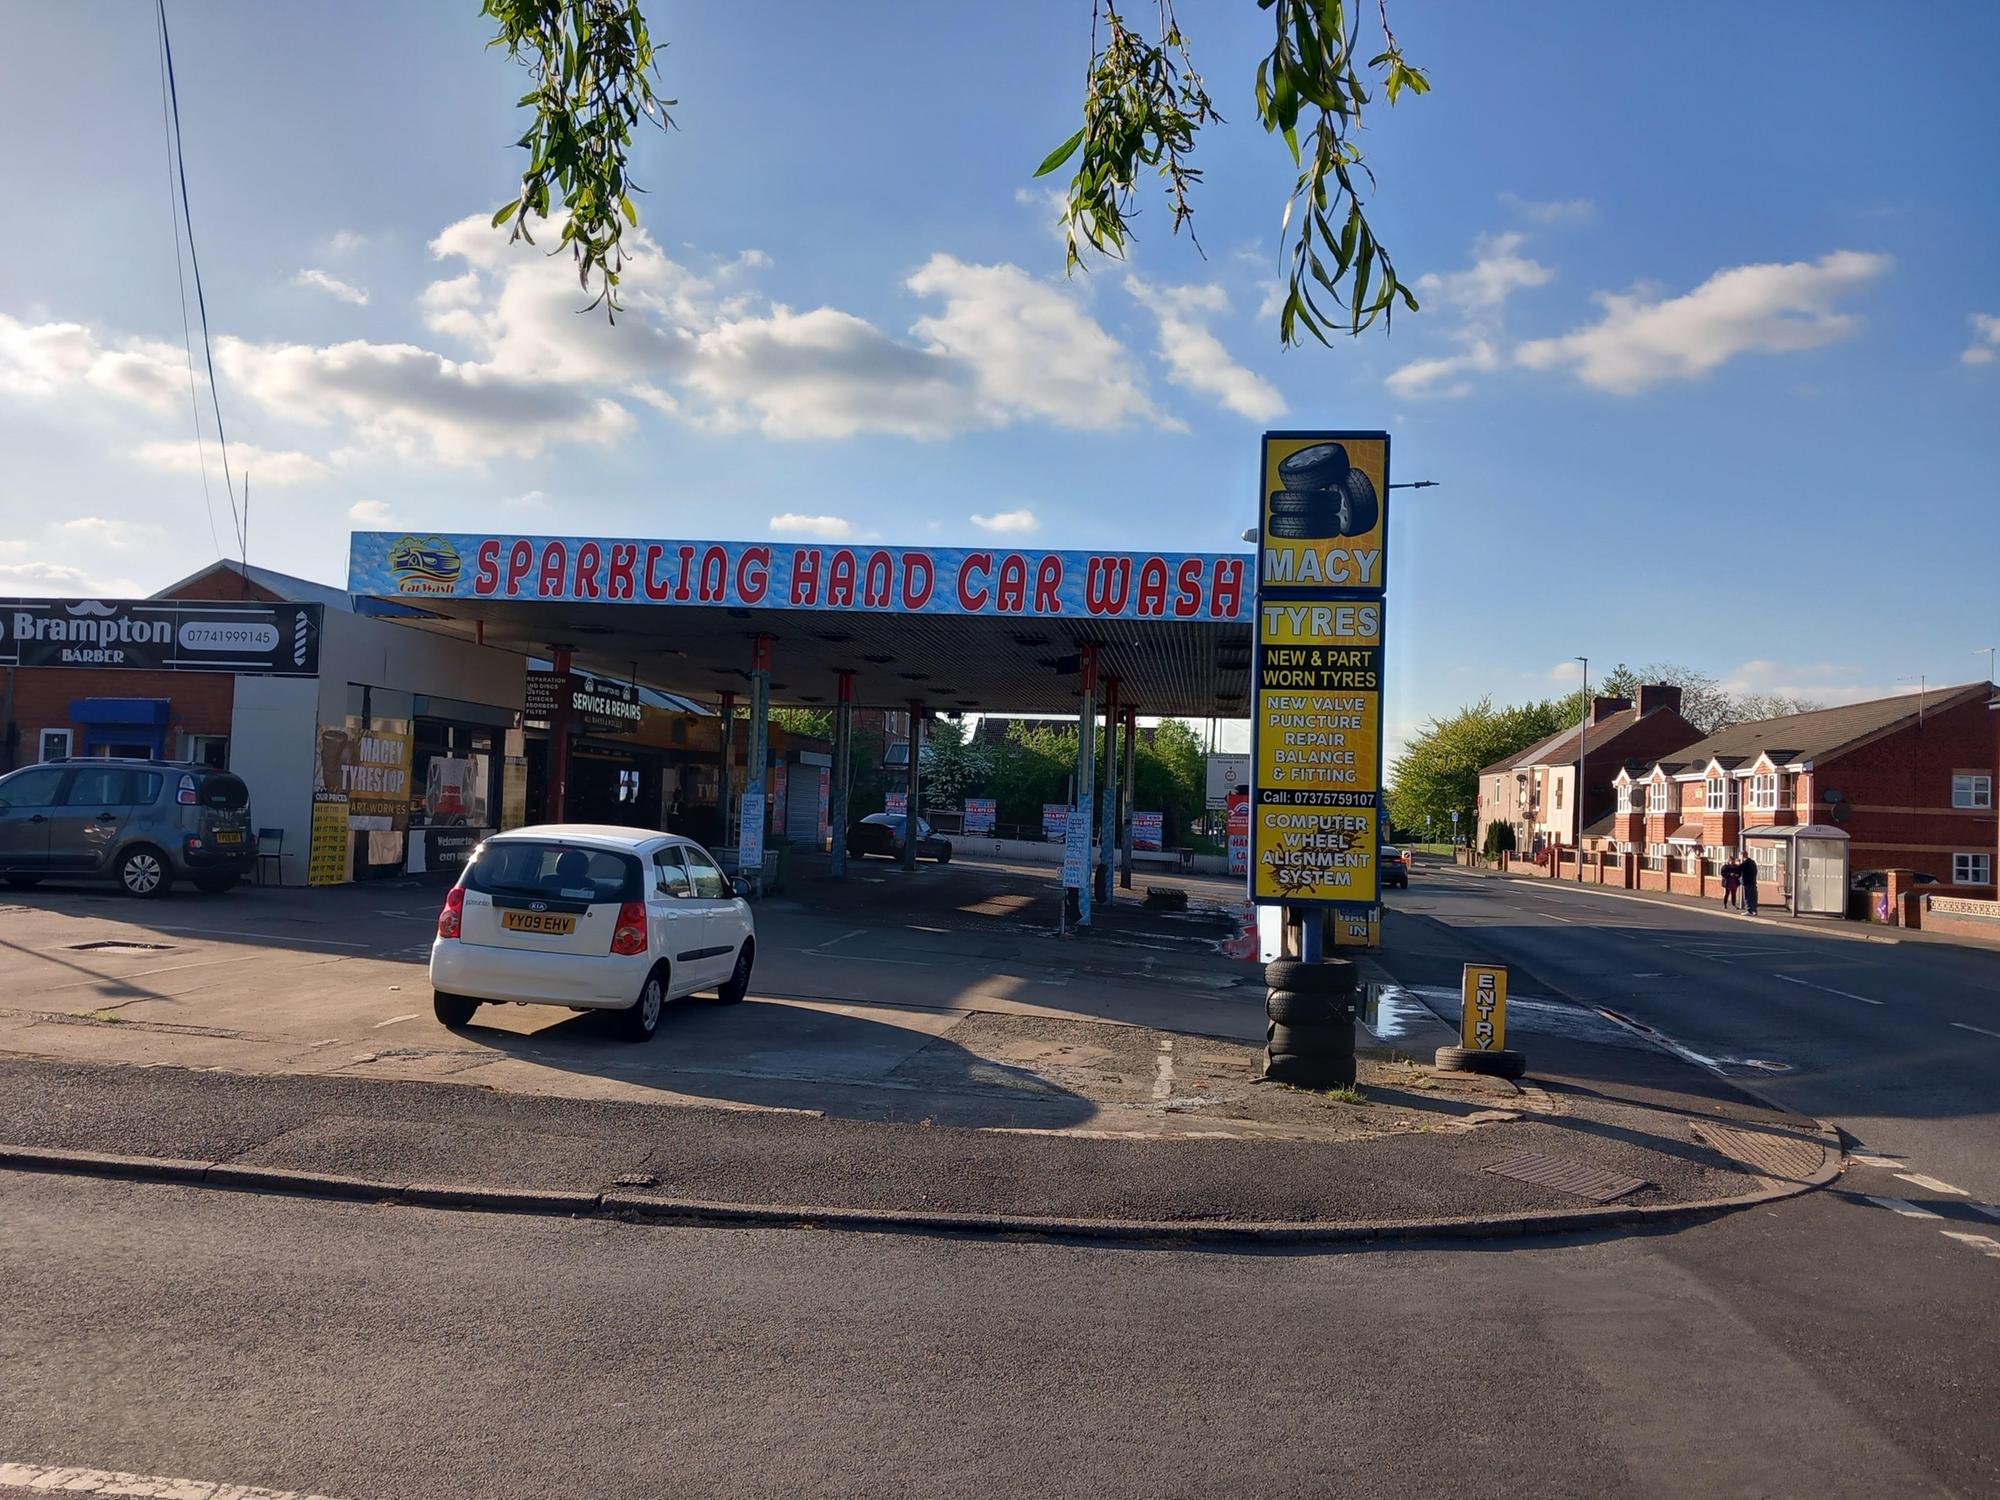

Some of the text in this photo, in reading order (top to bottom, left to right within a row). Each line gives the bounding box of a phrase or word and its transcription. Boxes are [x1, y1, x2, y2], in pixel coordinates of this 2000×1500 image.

[1264, 548, 1380, 583] MACY
[474, 538, 1244, 618] SPARKLING HAND CAR WASH
[13, 612, 171, 648] Brampton
[1263, 606, 1378, 637] TYRES
[187, 630, 270, 644] 07741999145
[62, 648, 124, 663] BARBER
[1267, 650, 1372, 667] NEW & PART
[1263, 670, 1376, 687] WORN TYRES
[572, 691, 641, 721] SERVICE & REPAIRS
[1267, 696, 1365, 711] NEW VALVE
[1270, 714, 1361, 729] PUNCTURE
[1285, 732, 1345, 747] REPAIR
[360, 736, 404, 765] MACEY
[1275, 750, 1355, 765] BALANCE
[1272, 768, 1357, 782] & FITTING
[1263, 791, 1374, 806] Call: 07375759107
[351, 802, 394, 814] ART-WORN
[1265, 813, 1367, 830] COMPUTER
[1232, 839, 1248, 847] HAN
[1282, 832, 1349, 849] WHEEL
[1236, 851, 1247, 860] CA
[1262, 850, 1370, 868] ALIGNMENT
[1279, 869, 1351, 886] SYSTEM
[531, 903, 545, 911] KIA
[508, 913, 570, 931] YY09 EHV
[1474, 974, 1496, 1050] ENTRY
